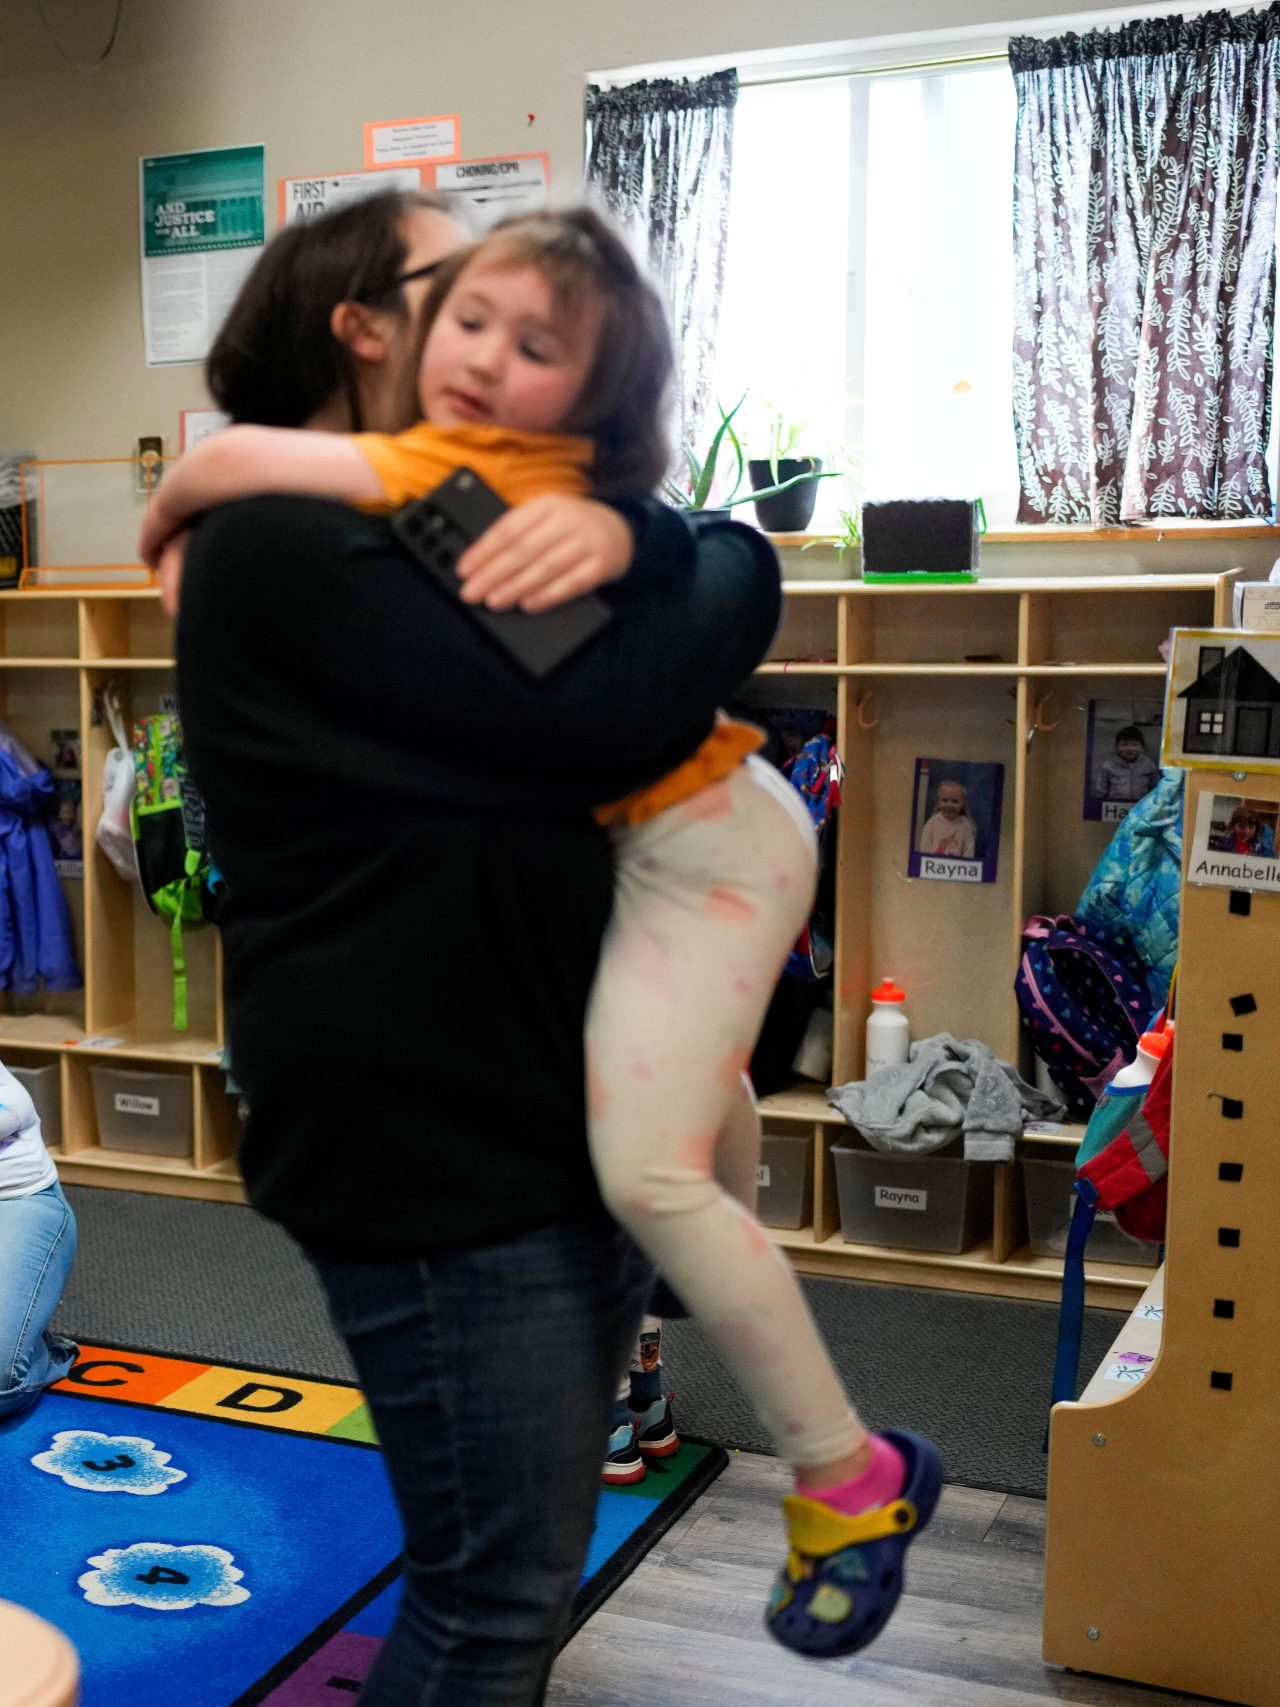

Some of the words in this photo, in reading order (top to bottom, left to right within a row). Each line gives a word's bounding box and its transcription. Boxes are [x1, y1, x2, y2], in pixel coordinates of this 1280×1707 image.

[456, 161, 519, 179] CHOKING/CPR
[293, 181, 326, 200] FIRST
[155, 201, 186, 216] AND
[155, 210, 216, 227] JUSTICE
[171, 224, 200, 239] ALL
[925, 860, 978, 878] Rayna
[880, 1188, 920, 1204] Rayna
[67, 1360, 145, 1386] C
[215, 1382, 303, 1413] D
[82, 1454, 136, 1472] 3
[135, 1565, 190, 1584] 4
